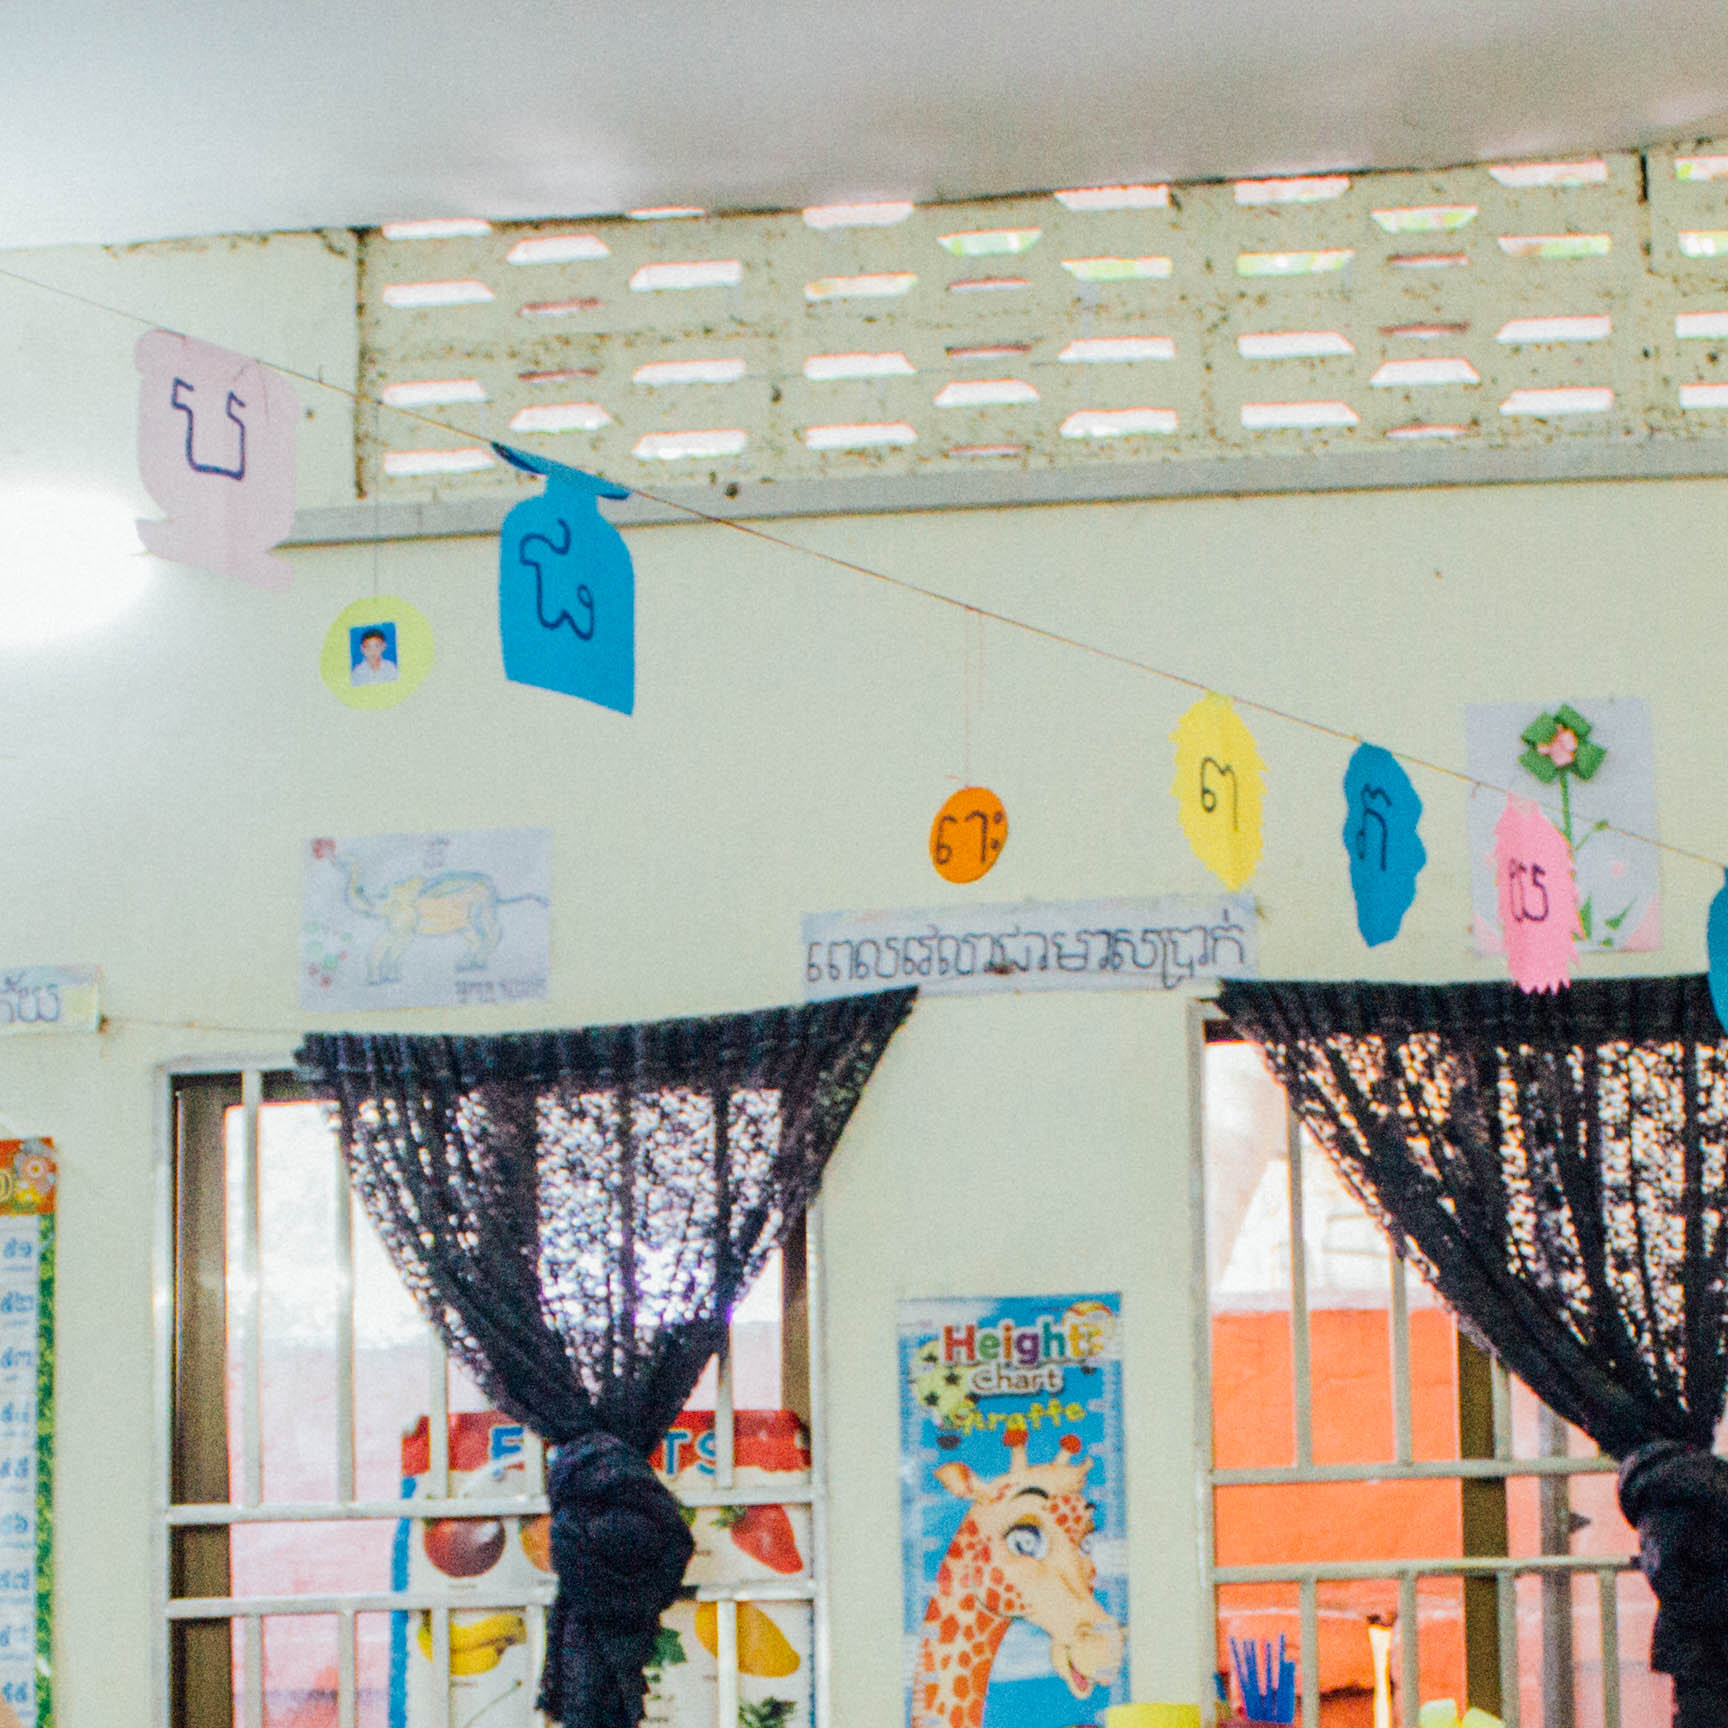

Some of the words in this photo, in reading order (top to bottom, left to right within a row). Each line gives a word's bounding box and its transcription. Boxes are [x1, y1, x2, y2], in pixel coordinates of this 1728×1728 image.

[942, 1320, 1092, 1367] Height
[971, 1365, 1063, 1393] Chart
[491, 1425, 720, 1477] FTS
